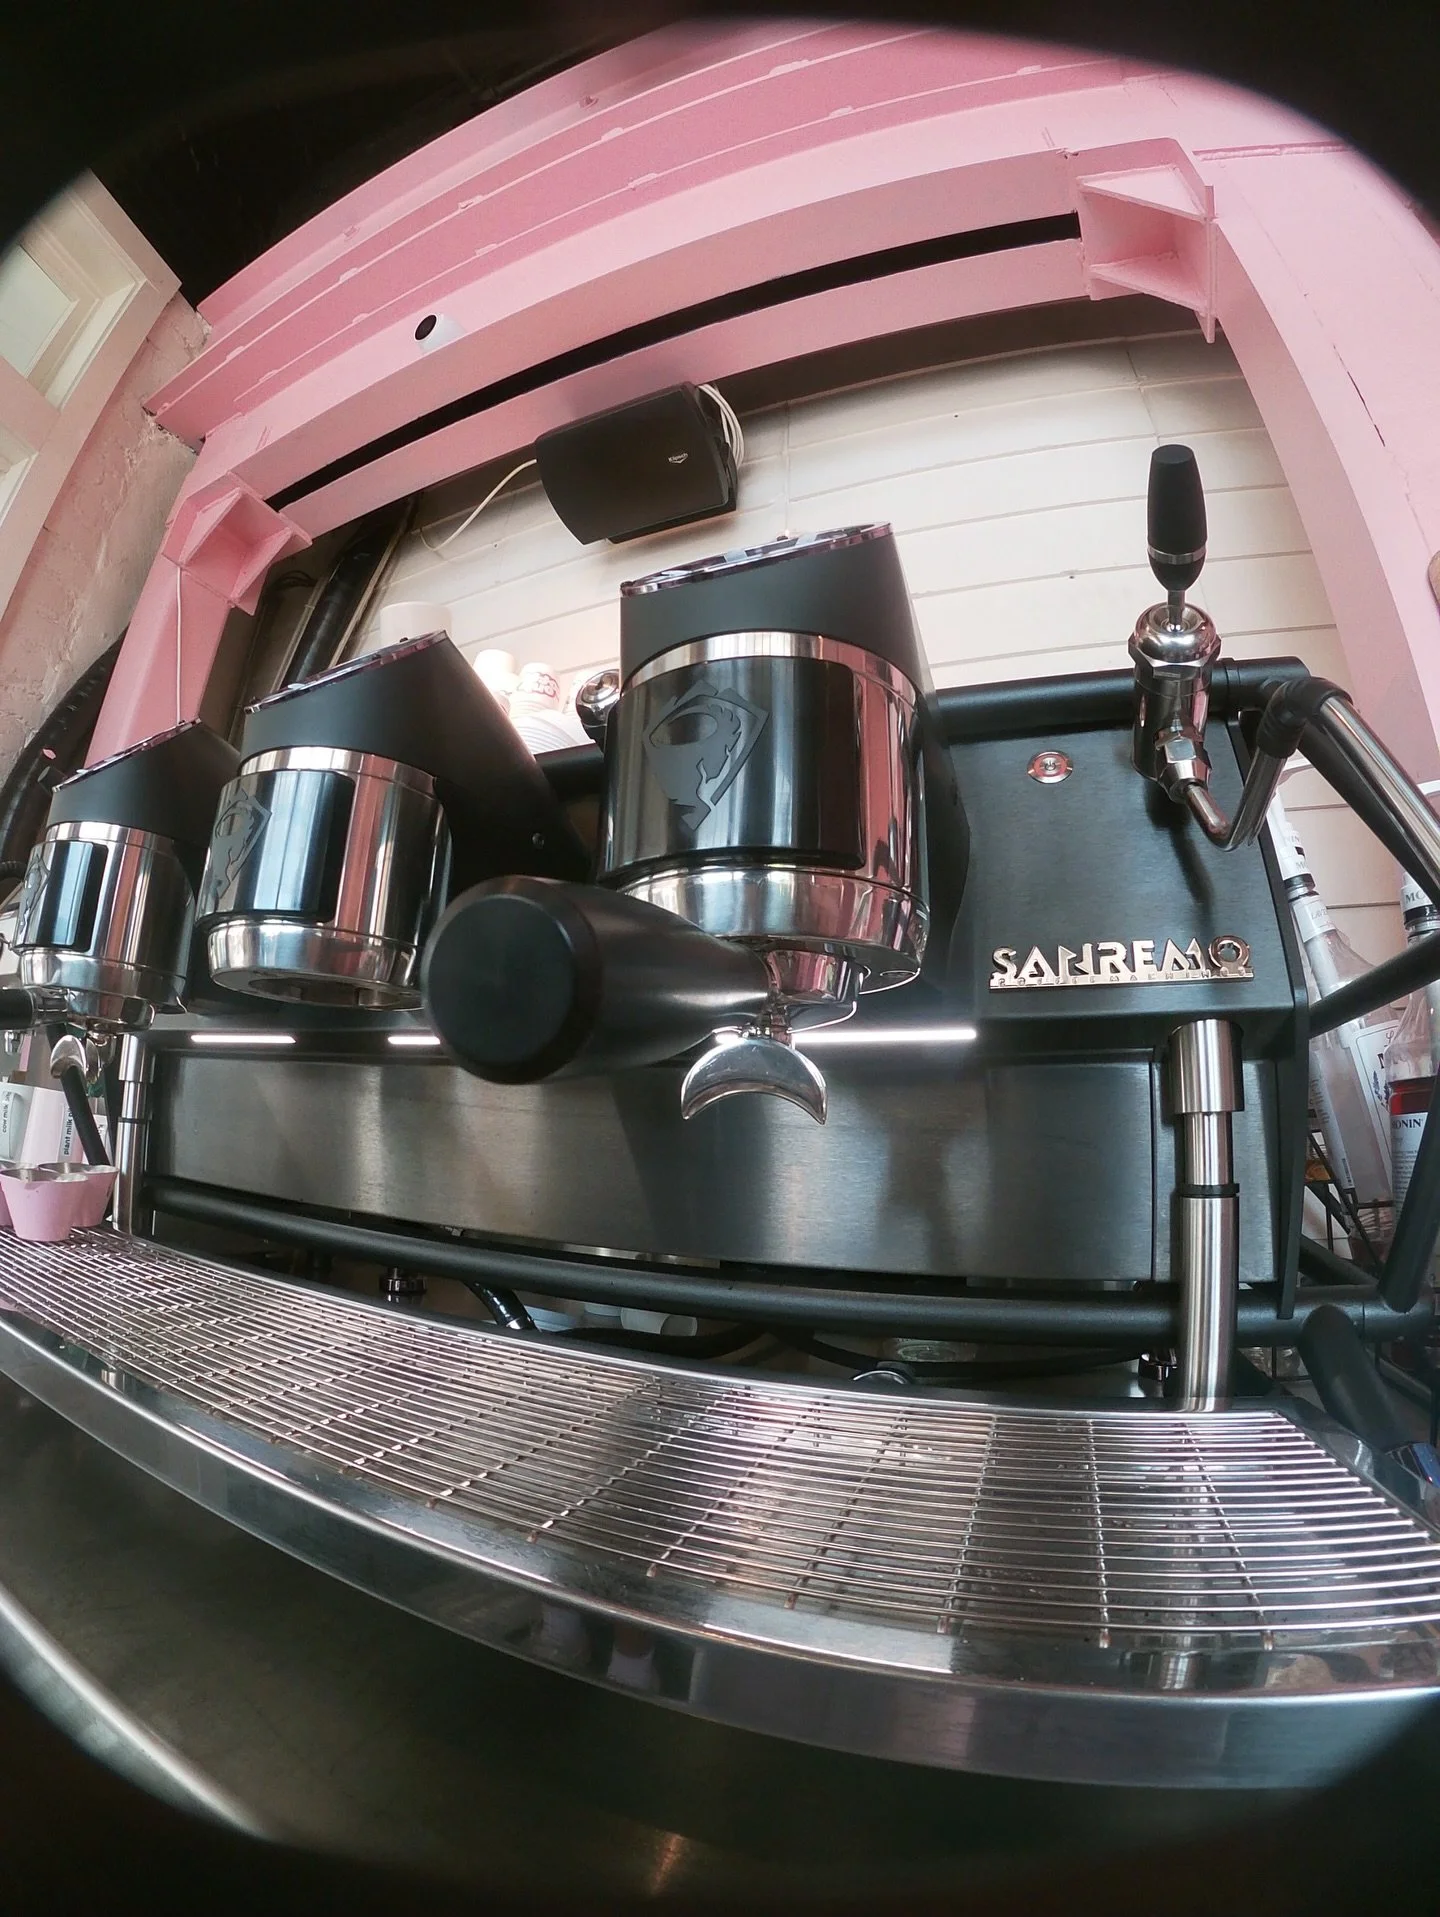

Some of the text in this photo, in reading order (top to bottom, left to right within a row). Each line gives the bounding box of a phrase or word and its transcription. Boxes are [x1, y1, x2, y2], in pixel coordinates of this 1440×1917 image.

[1405, 890, 1426, 904] MO
[991, 935, 1252, 979] SANREMO
[65, 1119, 73, 1135] milk
[63, 1136, 71, 1155] plant
